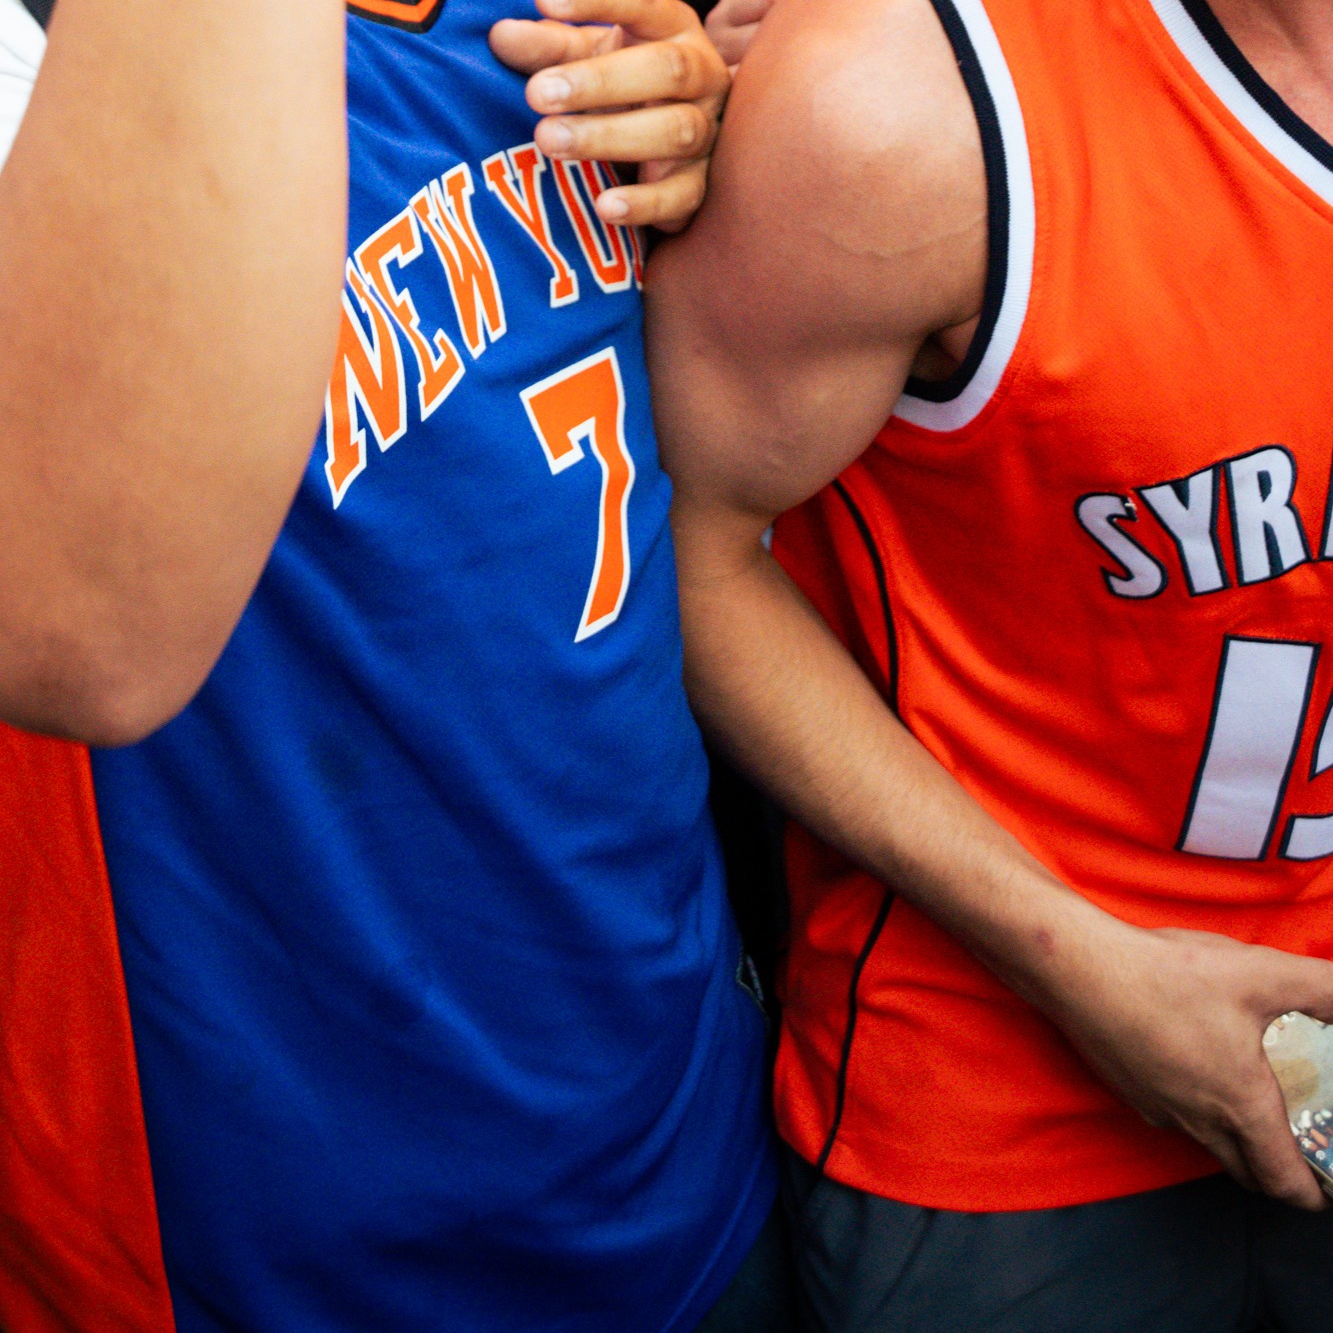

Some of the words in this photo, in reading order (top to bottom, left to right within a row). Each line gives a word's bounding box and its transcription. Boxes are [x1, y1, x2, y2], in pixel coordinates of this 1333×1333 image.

[324, 161, 507, 510] NEW
[481, 141, 643, 309] YO
[519, 345, 636, 644] 7
